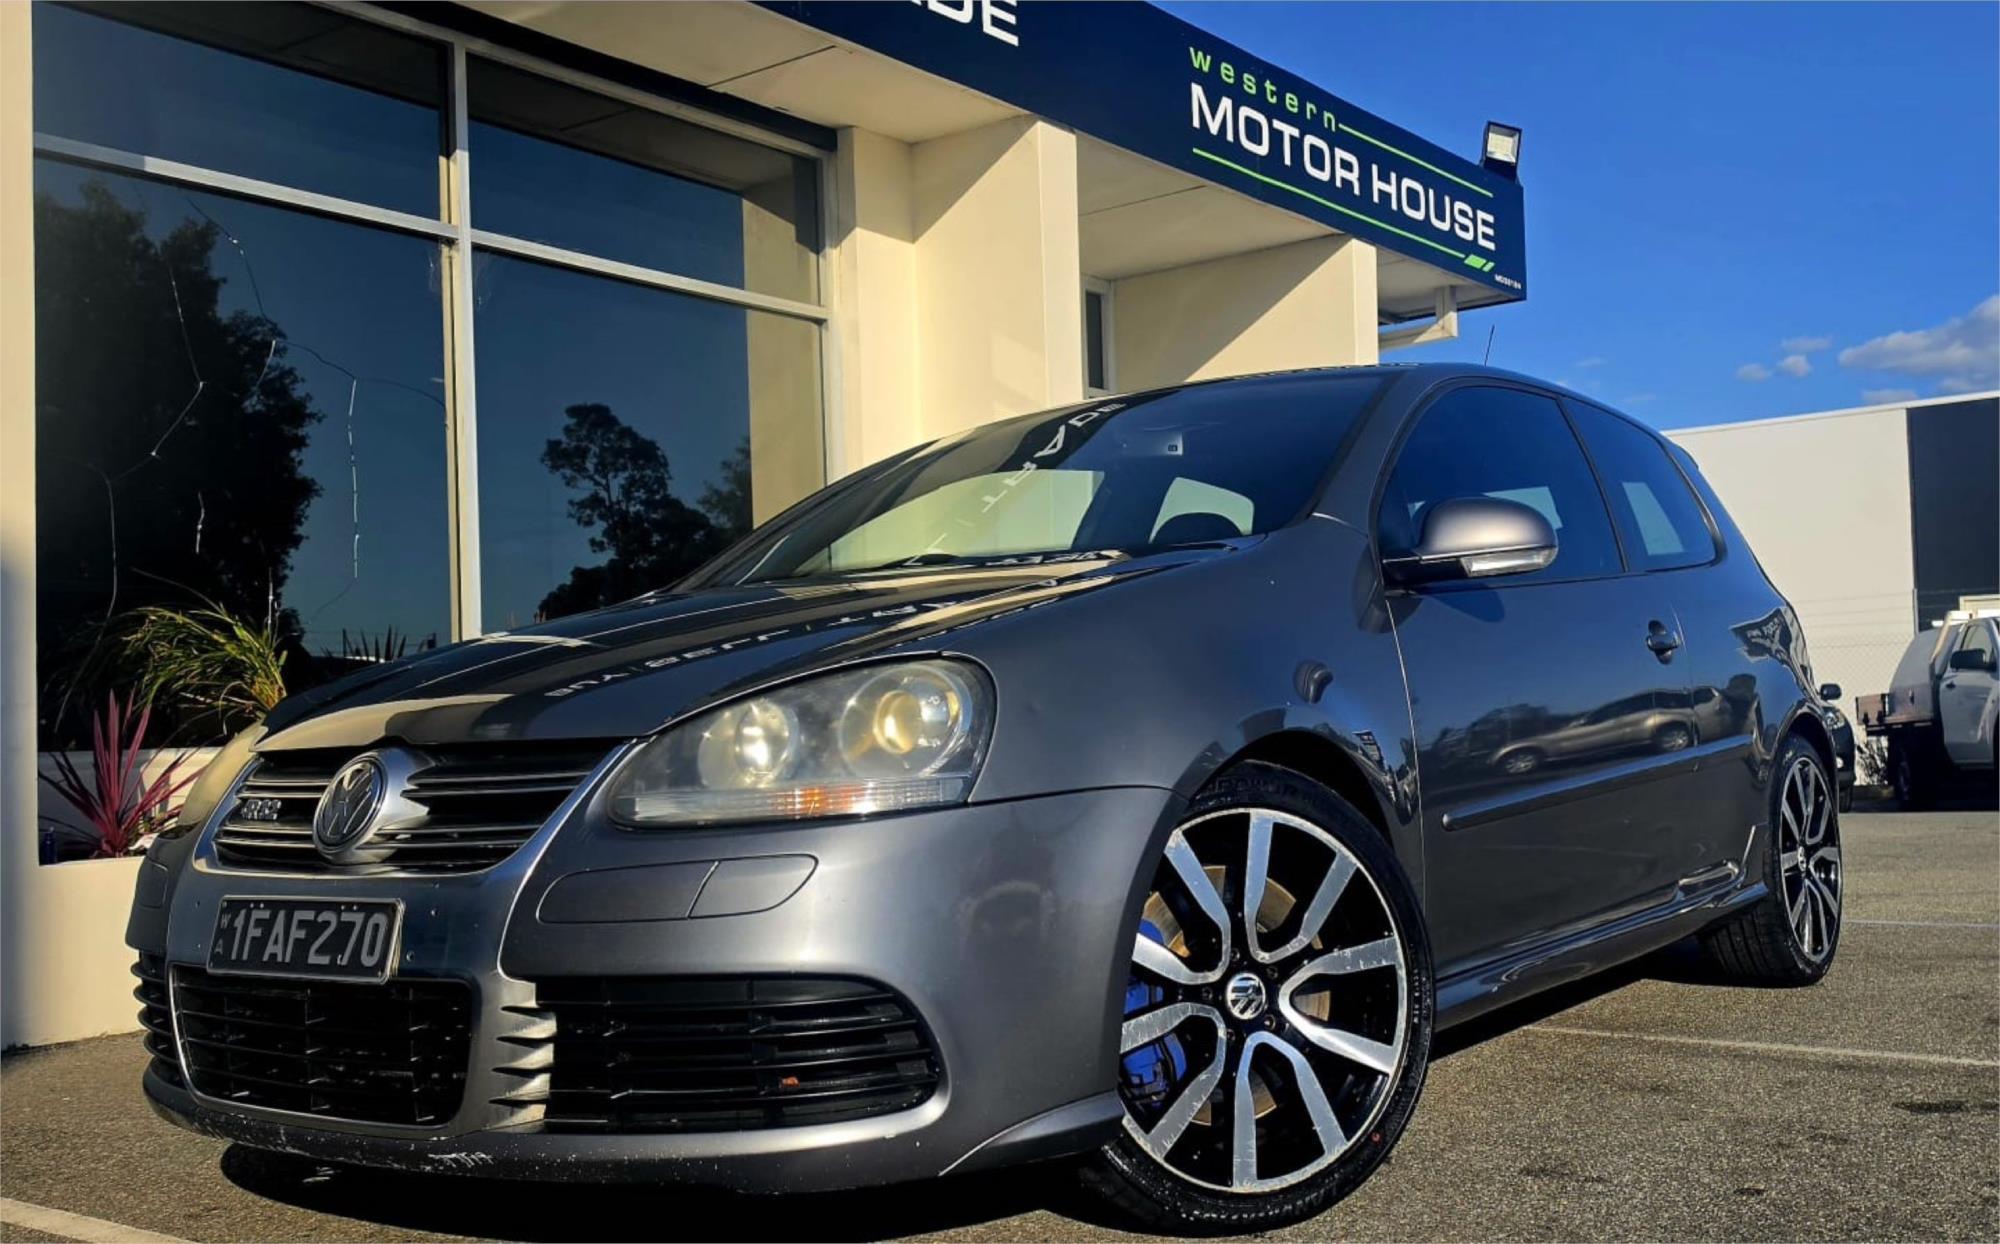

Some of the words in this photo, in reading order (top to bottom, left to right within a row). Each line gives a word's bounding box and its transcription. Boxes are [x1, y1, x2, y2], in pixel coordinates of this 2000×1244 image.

[1189, 46, 1336, 132] western
[1190, 82, 1361, 196] MOTOR
[1371, 163, 1496, 251] HOUSE
[230, 908, 390, 968] 1FAF270
